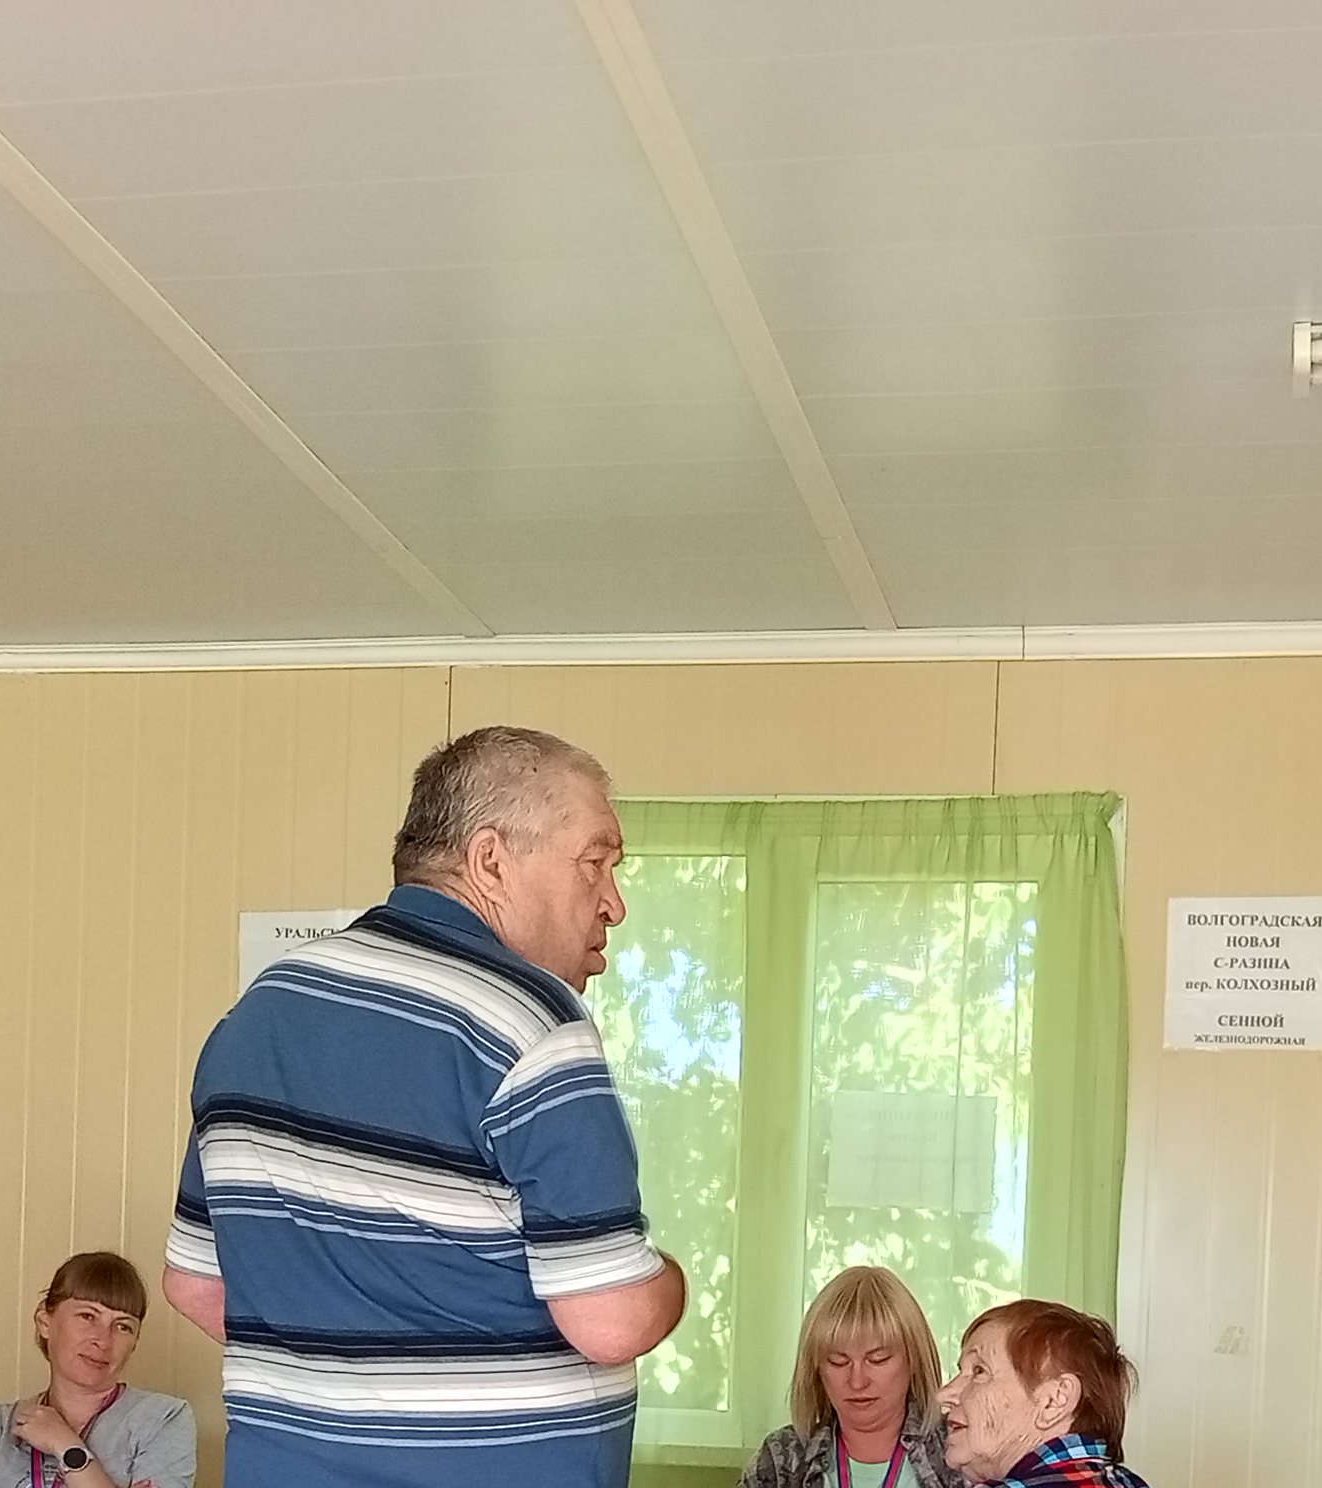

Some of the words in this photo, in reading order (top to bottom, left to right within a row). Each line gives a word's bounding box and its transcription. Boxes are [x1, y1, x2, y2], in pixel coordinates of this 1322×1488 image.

[1187, 914, 1322, 928] ВОЛГОГРАДСКАЯ
[1226, 935, 1281, 948] НОВАЯ
[1213, 957, 1290, 970] С-РАЗИНА
[1185, 981, 1212, 993] пер.
[1216, 977, 1316, 991] КОЛХОЗНЫЙ
[1217, 1013, 1284, 1028] СЕННОЙ
